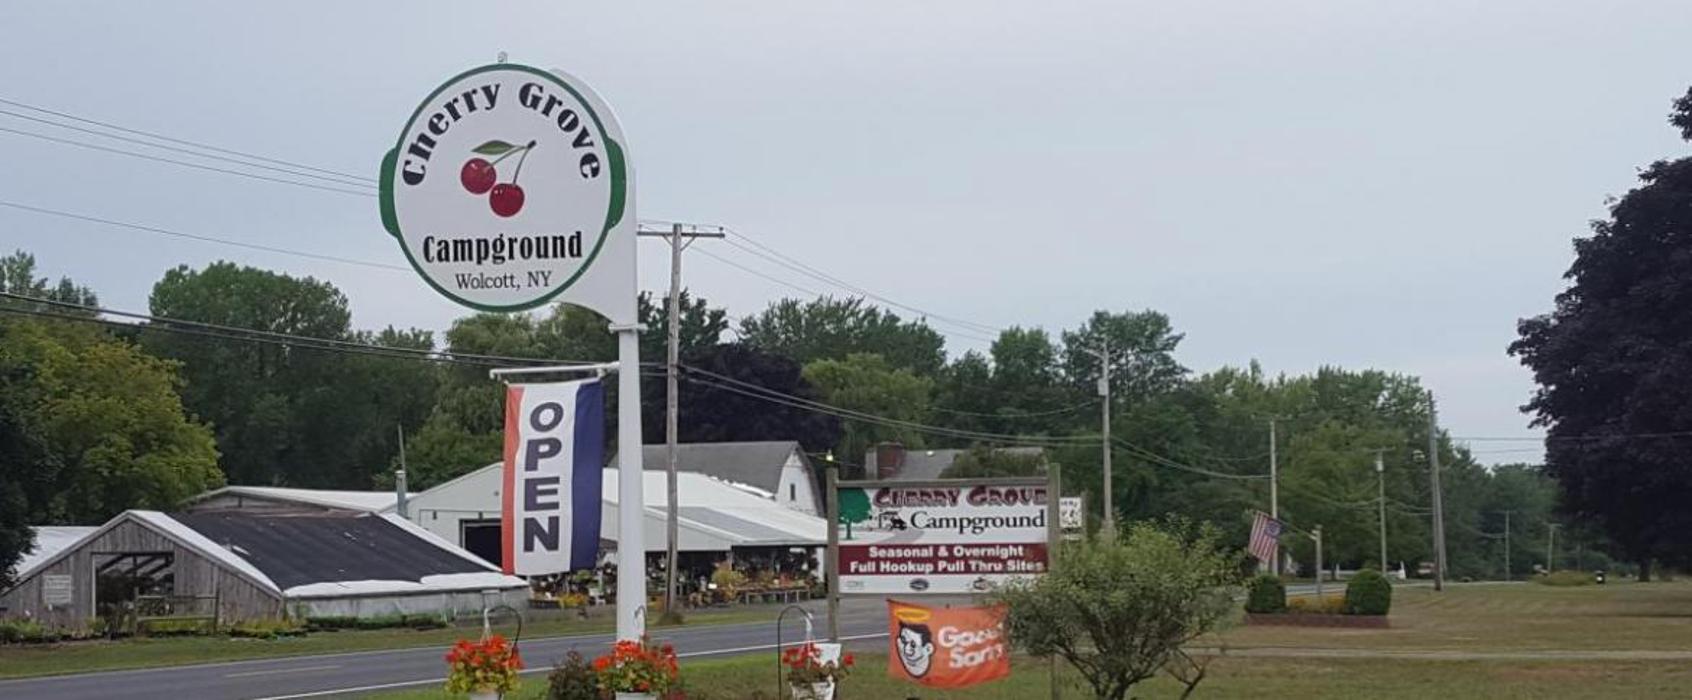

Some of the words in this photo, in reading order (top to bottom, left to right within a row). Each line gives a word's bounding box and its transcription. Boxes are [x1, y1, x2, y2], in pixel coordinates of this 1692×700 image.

[402, 82, 501, 186] Cherry
[519, 81, 601, 179] Grove
[423, 231, 582, 265] Campground
[455, 272, 521, 291] Wolcott,
[528, 271, 552, 288] NY
[523, 401, 564, 552] OPEN
[910, 509, 1045, 535] Campground
[869, 546, 933, 557] Seasonal
[938, 546, 949, 558] &
[954, 545, 1024, 559] Overnight
[850, 562, 876, 573] Full
[880, 561, 933, 574] Hookup
[938, 561, 965, 572] Pull
[971, 560, 1003, 572] Thru
[1007, 560, 1044, 572] Sites
